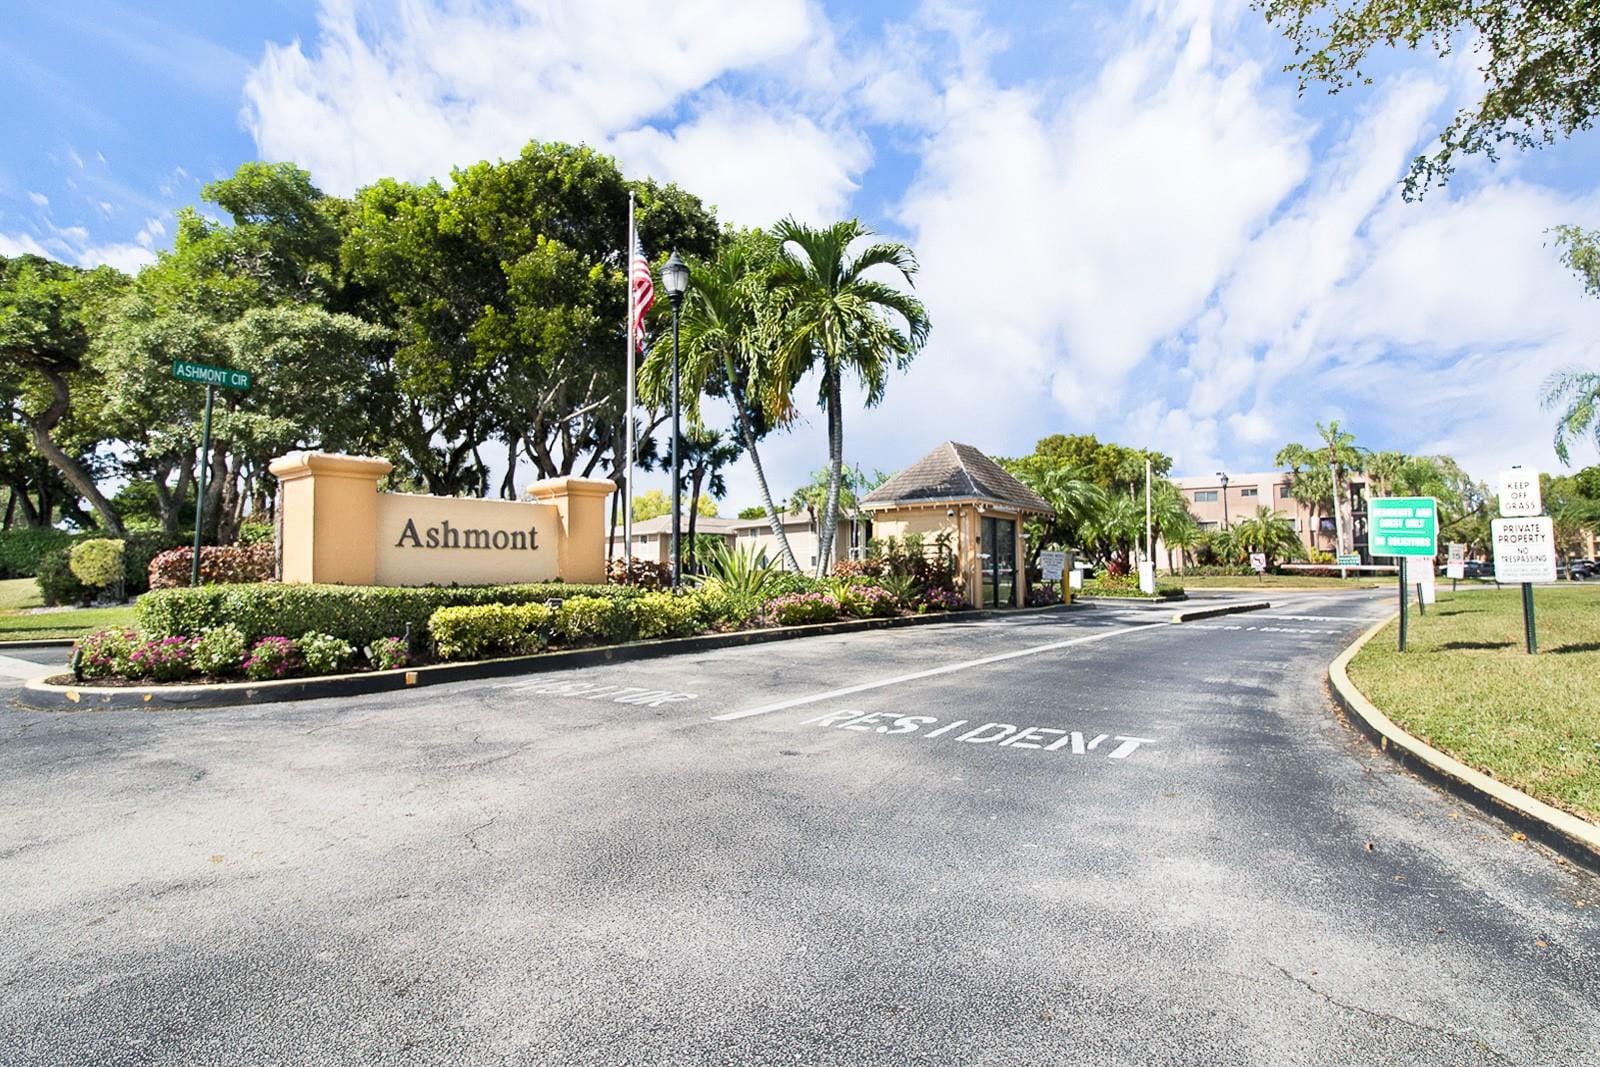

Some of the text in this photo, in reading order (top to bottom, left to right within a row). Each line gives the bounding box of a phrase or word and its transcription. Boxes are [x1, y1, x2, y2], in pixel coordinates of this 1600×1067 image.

[176, 364, 248, 386] ASHMONT CIR
[1507, 481, 1530, 490] KEEP
[1511, 492, 1528, 500] OFF
[1505, 502, 1536, 511] GRASS
[1503, 523, 1540, 533] PRIVATE
[395, 517, 539, 550] Ashmont
[1498, 534, 1546, 543] PROPERTY
[1501, 555, 1547, 563] TRESPASSING
[800, 709, 1157, 758] RESIDENT
